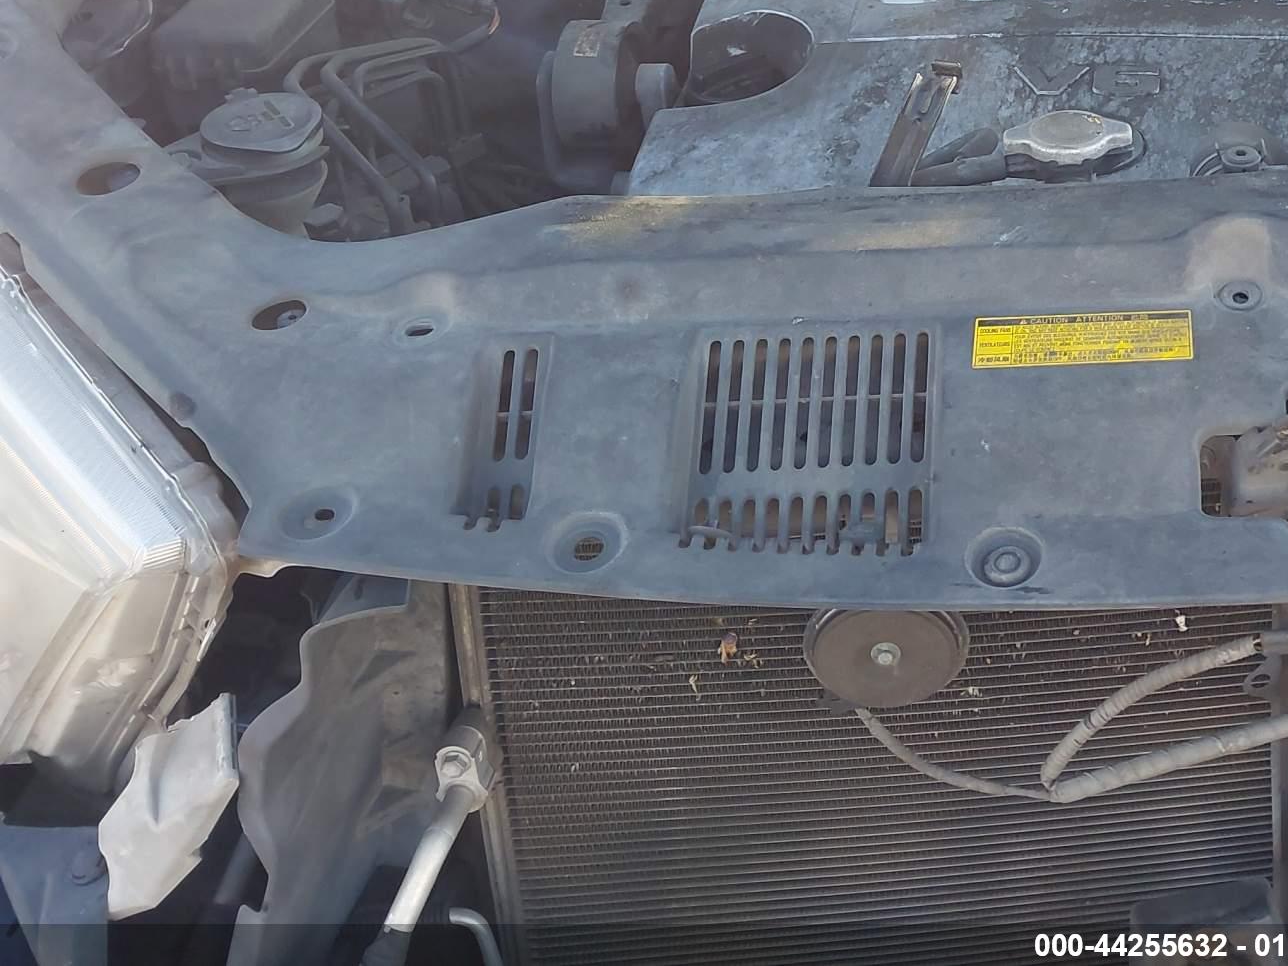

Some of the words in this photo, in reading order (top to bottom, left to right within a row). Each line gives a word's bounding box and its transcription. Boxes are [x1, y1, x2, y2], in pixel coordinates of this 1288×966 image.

[1011, 64, 1161, 97] V6
[1028, 316, 1069, 325] CAUTION
[1075, 313, 1124, 323] ATTENTION
